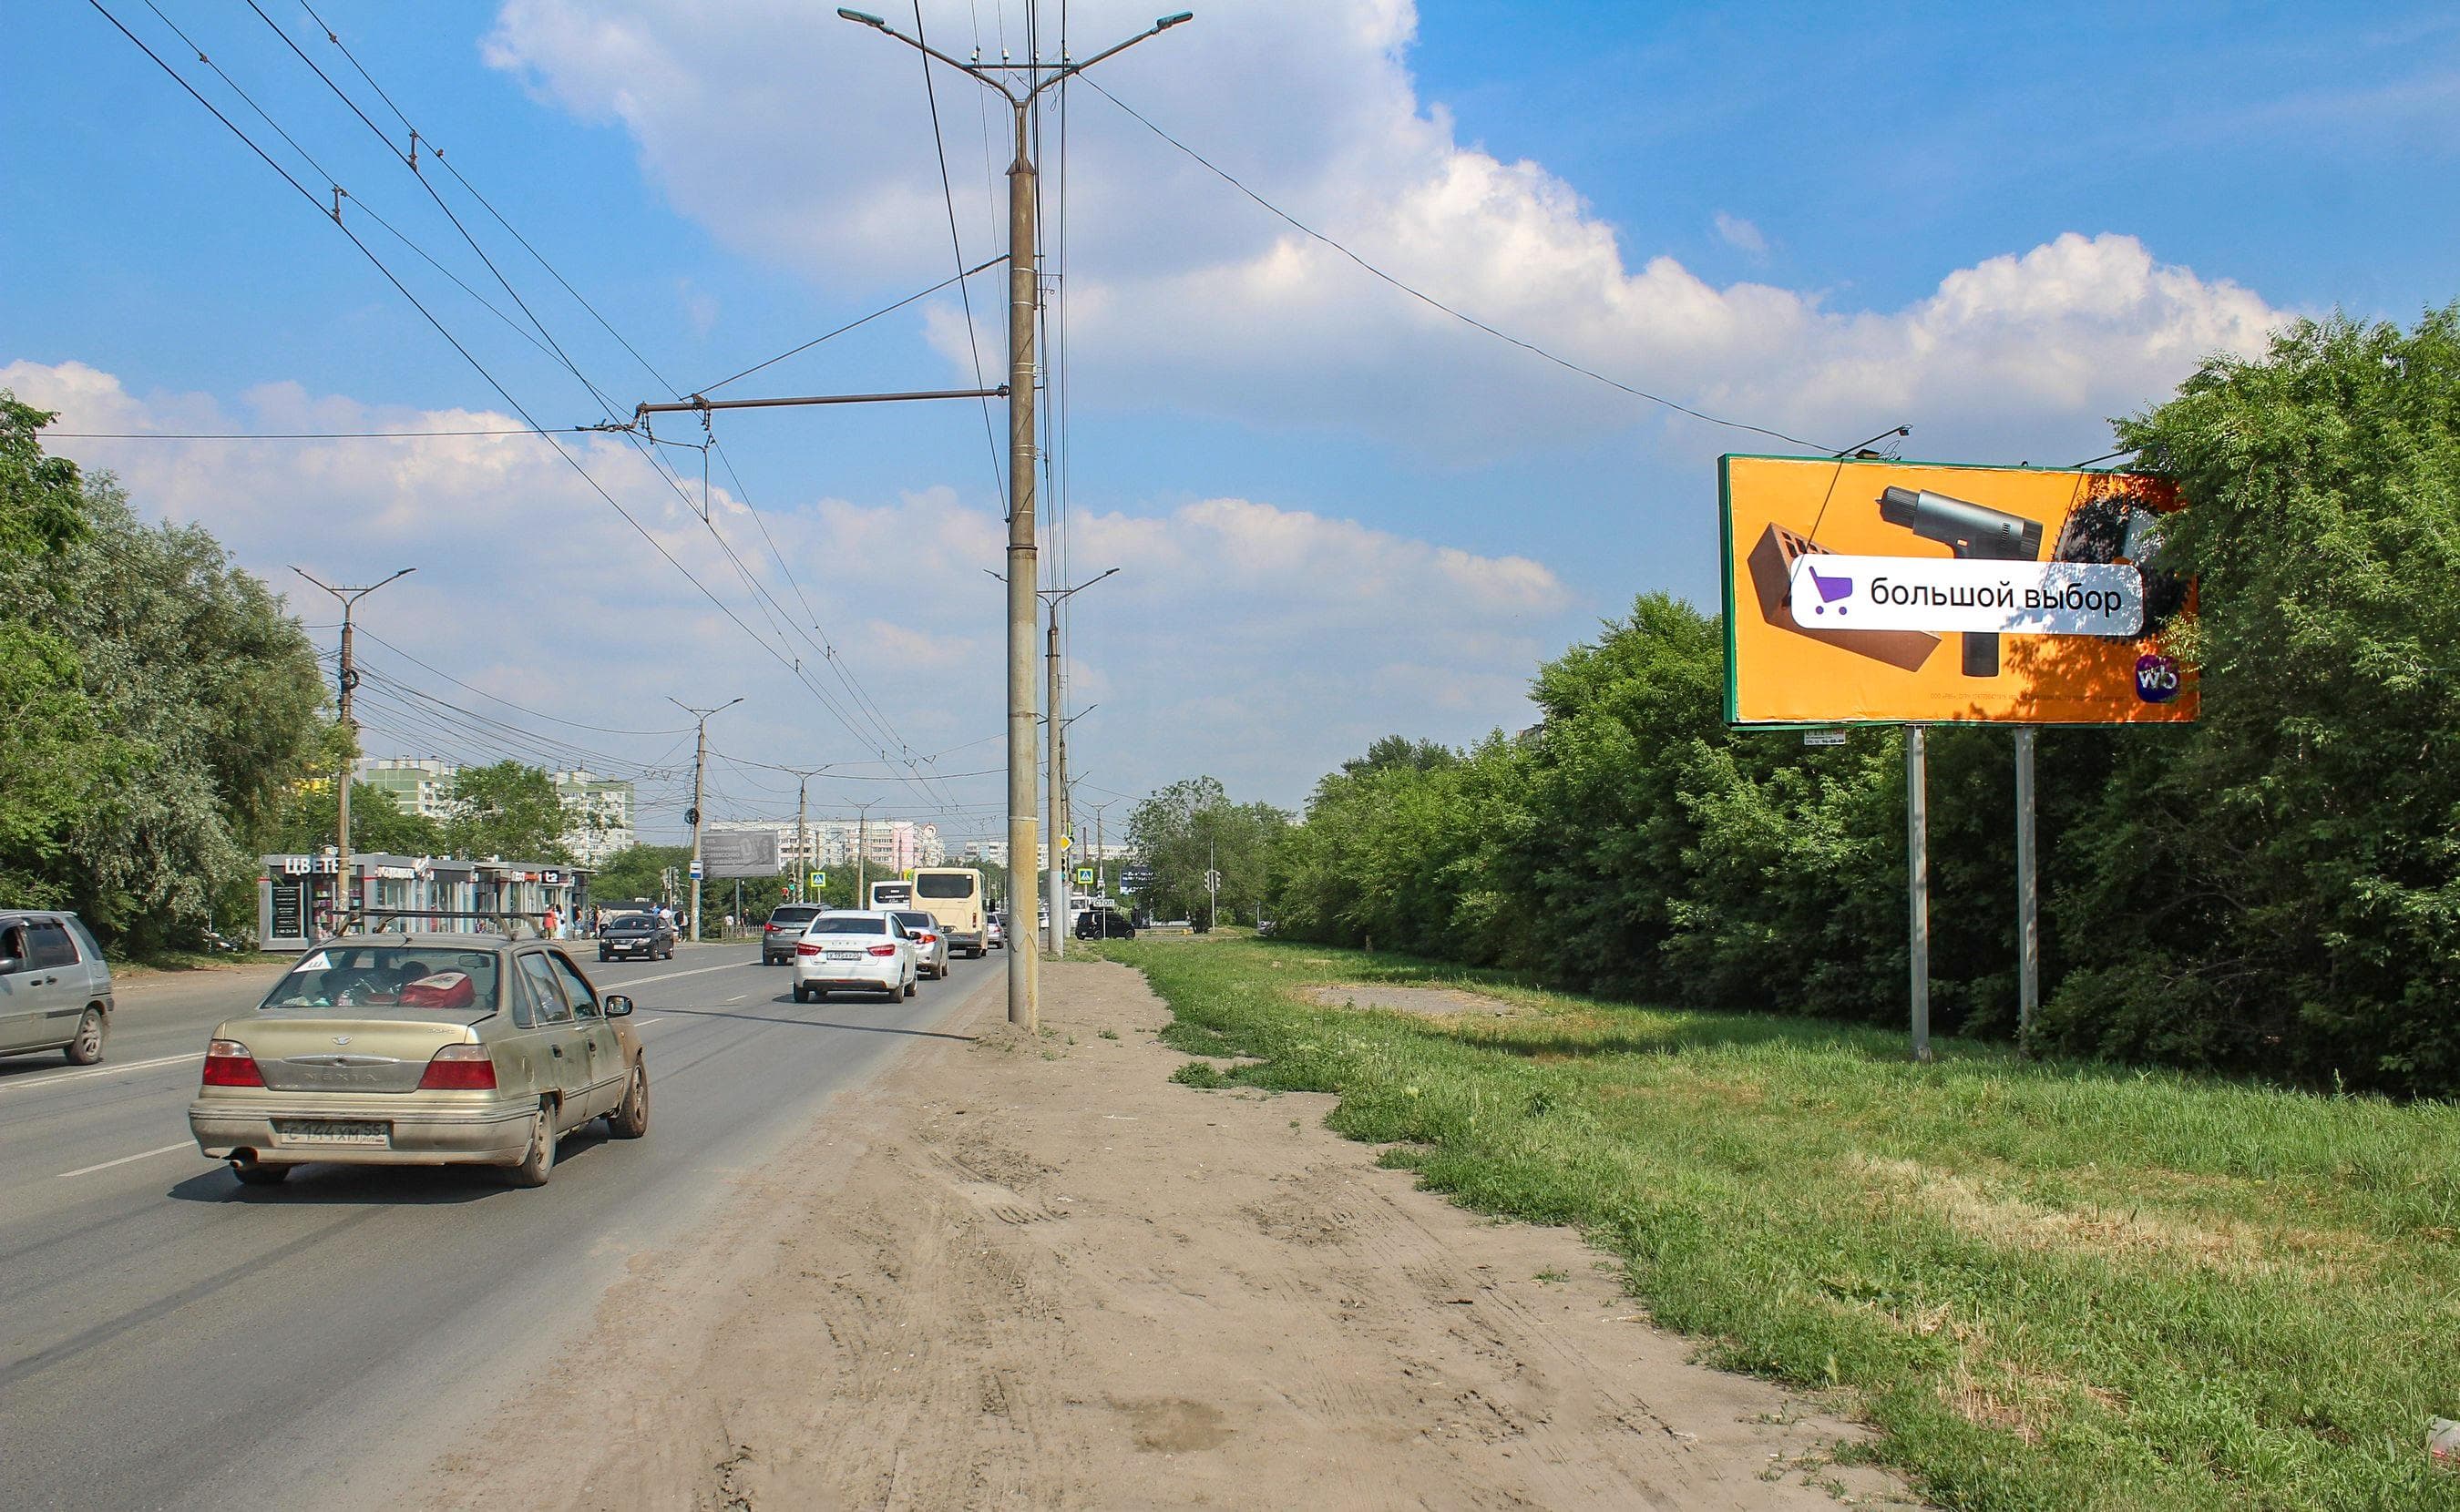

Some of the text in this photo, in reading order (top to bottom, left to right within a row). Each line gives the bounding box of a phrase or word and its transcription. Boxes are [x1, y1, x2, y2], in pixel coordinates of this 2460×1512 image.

[1871, 577, 2122, 618] большой выбор
[303, 1073, 378, 1082] NEXIA
